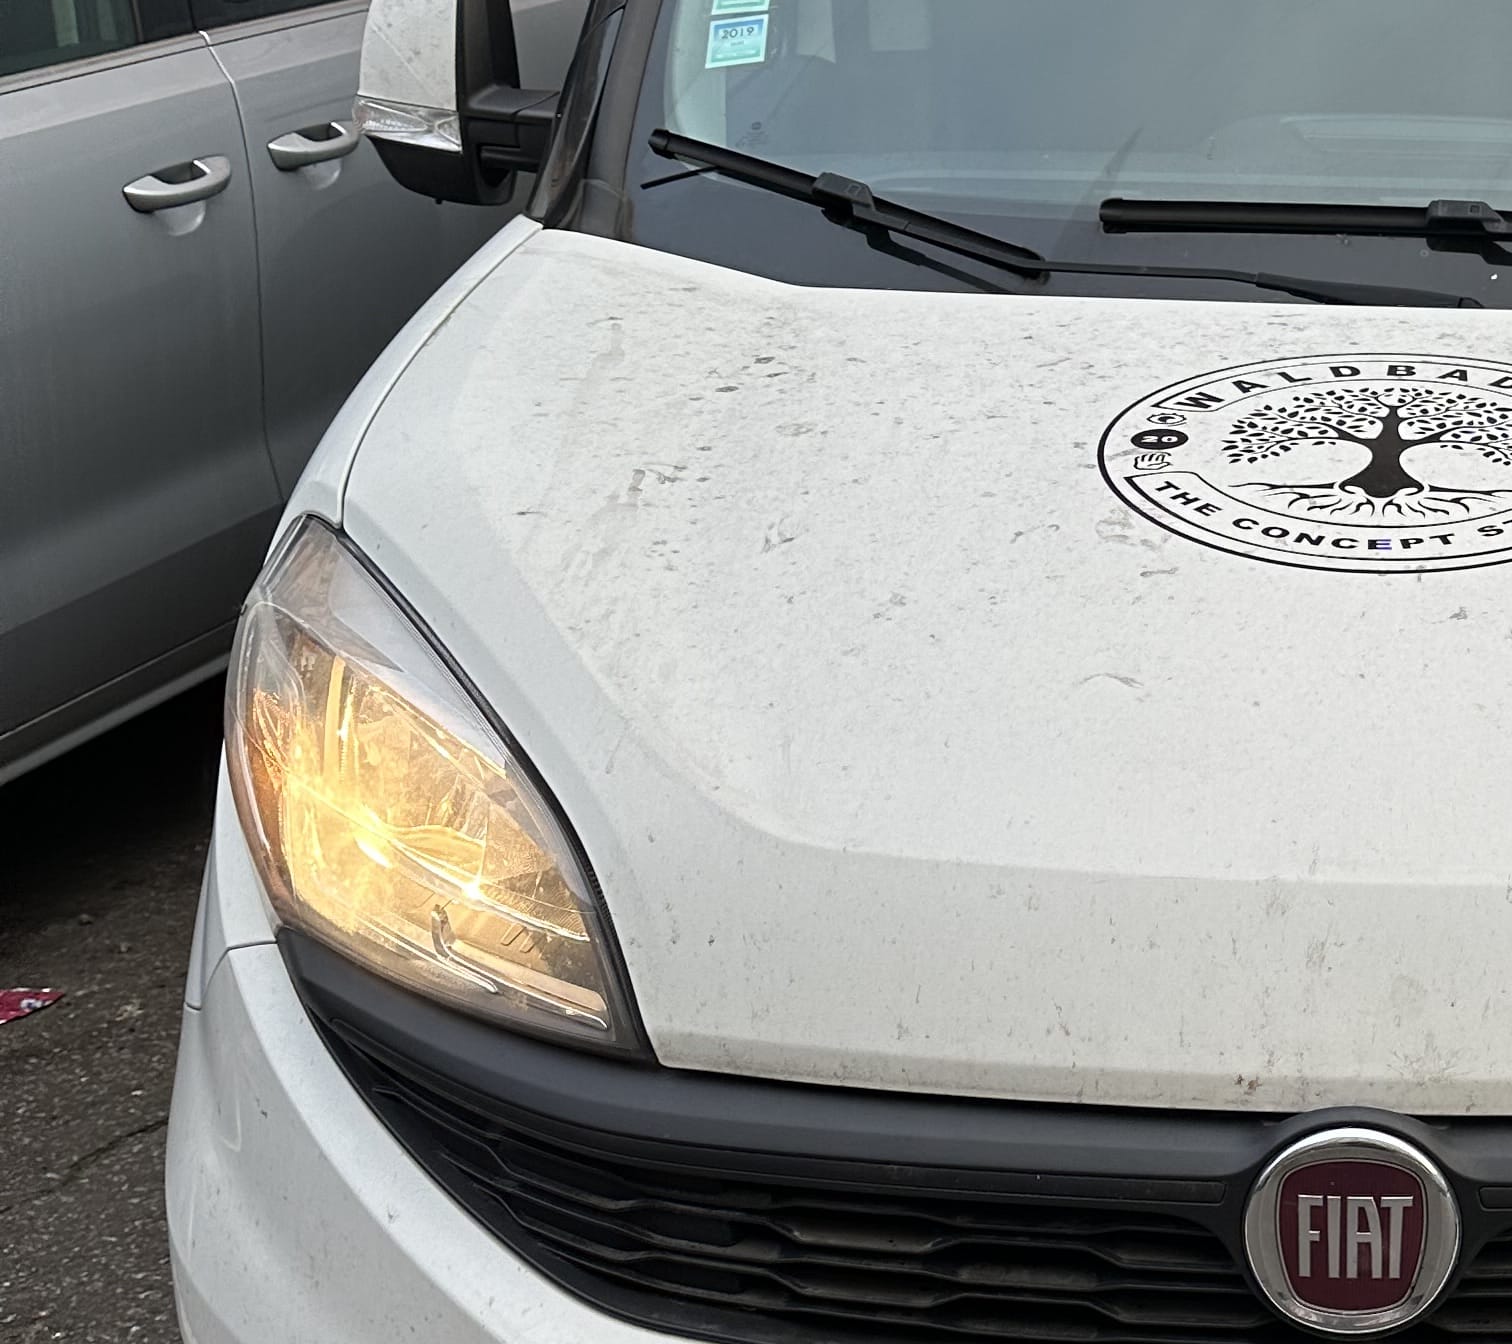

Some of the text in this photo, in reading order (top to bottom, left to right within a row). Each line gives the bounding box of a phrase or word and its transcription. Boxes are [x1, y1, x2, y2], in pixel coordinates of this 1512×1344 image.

[720, 26, 755, 40] 2019
[1155, 480, 1225, 518] THE
[1232, 517, 1456, 550] CONCEPT
[1297, 1194, 1414, 1279] FIAT
